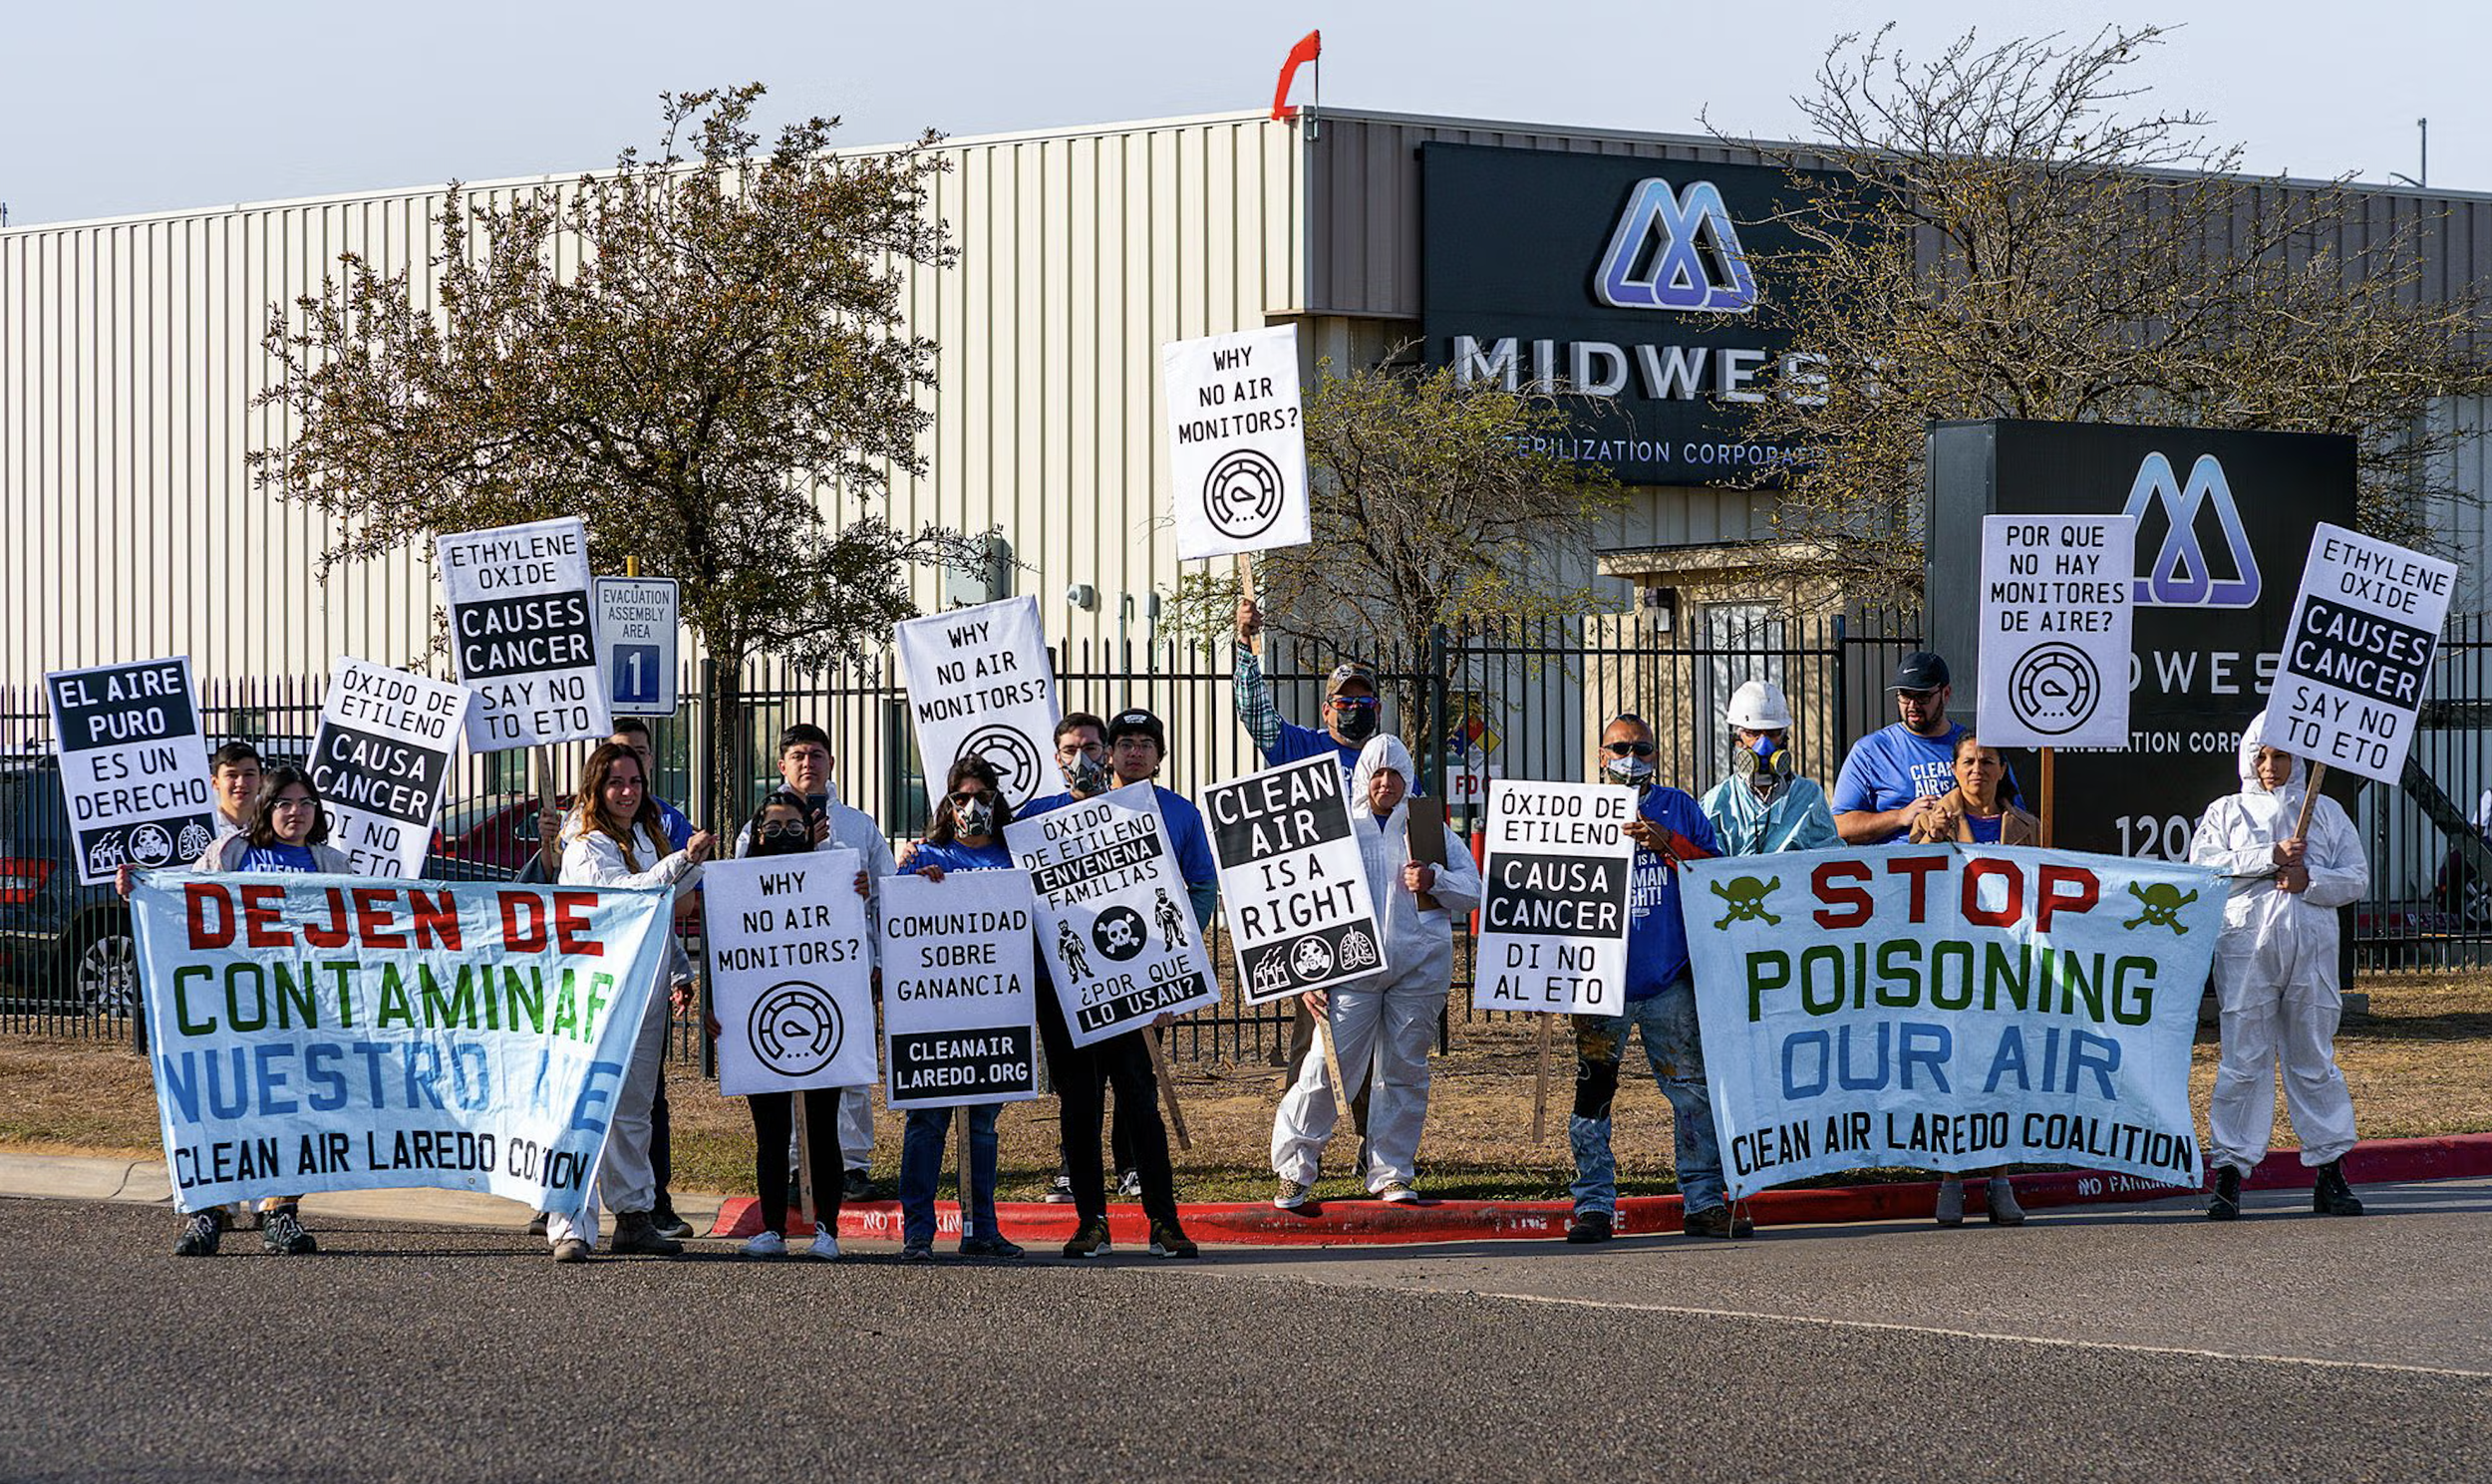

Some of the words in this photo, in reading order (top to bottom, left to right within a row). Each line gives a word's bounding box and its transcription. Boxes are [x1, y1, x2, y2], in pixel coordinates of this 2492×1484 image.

[1213, 346, 1252, 371] WHY
[1199, 385, 1224, 407] NO
[1234, 377, 1273, 402] AIR
[1179, 408, 1298, 444] MONITORS?
[452, 534, 577, 567] ETHYLENE
[2007, 525, 2049, 547] POR
[2060, 525, 2104, 548] QUE
[478, 562, 556, 589] OXIDE
[2011, 554, 2038, 575] NO
[2056, 554, 2099, 575] HAY
[2323, 539, 2448, 597] ETHYLENE
[604, 589, 669, 605] EVACUATION
[1992, 582, 2125, 604] MONITORES
[2340, 572, 2416, 615] OXIDE
[462, 598, 585, 637] CAUSES
[609, 606, 665, 622] ASSEMBLY
[622, 625, 650, 638] AREA
[2001, 611, 2028, 632] DE
[2040, 611, 2113, 632] AIRE?
[947, 621, 989, 648] WHY
[2306, 605, 2426, 667] CAUSES
[466, 637, 589, 673] CANCER
[937, 662, 966, 685] NO
[976, 651, 1017, 678] AIR
[2296, 641, 2416, 703] CANCER
[58, 681, 98, 709] EL
[107, 667, 182, 700] AIRE
[343, 665, 418, 706] ÓXIDO
[427, 691, 457, 717] DE
[628, 652, 641, 696] 1
[482, 683, 534, 711] SAY
[550, 676, 585, 702] NO
[919, 679, 1046, 724] MONITORS?
[89, 708, 166, 742] PURO
[341, 695, 446, 739] ETILENO
[484, 714, 519, 740] TO
[535, 707, 589, 735] ETO
[2294, 686, 2349, 725] SAY
[2358, 708, 2396, 740] NO
[331, 734, 425, 781] CAUSA
[2288, 717, 2321, 749] TO
[2332, 728, 2388, 769] ETO
[93, 753, 129, 781] ES
[142, 746, 177, 774] UN
[76, 777, 206, 820] DERECHO
[313, 764, 429, 818] CANCER
[1214, 764, 1335, 825] CLEAN
[1501, 788, 1581, 818] ÓXIDO
[1596, 798, 1626, 819] DE
[1915, 779, 1940, 797] AIR
[364, 821, 400, 851] NO
[1044, 804, 1111, 842] ÓXIDO
[1251, 814, 1321, 857] AIR
[1504, 822, 1618, 845] ETILENO
[2115, 814, 2202, 860] 120
[1023, 852, 1052, 873] DE
[1061, 813, 1155, 861] ETILENO
[1638, 854, 1648, 866] IS
[1650, 853, 1657, 864] A
[761, 871, 805, 896] WHY
[1042, 842, 1152, 890] ENVENENA
[1264, 860, 1297, 892] IS
[1308, 853, 1325, 878] A
[1504, 860, 1609, 892] CAUSA
[1632, 866, 1668, 887] MAN
[1048, 862, 1158, 911] FAMILIAS
[1811, 856, 2100, 933] STOP
[184, 882, 462, 951] DEJEN
[496, 891, 603, 956] DE
[744, 910, 773, 933] NO
[785, 904, 830, 929] AIR
[888, 910, 1027, 938] COMUNIDAD
[1240, 879, 1357, 940] RIGHT
[1489, 897, 1617, 931] CANCER
[719, 939, 859, 972] MONITORS?
[921, 944, 996, 968] SOBRE
[1507, 944, 1539, 969] DI
[1559, 945, 1596, 972] NO
[897, 974, 1021, 1001] GANANCIA
[1081, 973, 1132, 1006] ¿POR
[1148, 955, 1190, 984] QUE
[1495, 975, 1530, 1002] AL
[1546, 978, 1603, 1005] ETO
[1746, 939, 2158, 1026] POISONING
[1087, 1004, 1113, 1029] LO
[1131, 979, 1195, 1017] USAN?
[909, 1037, 1014, 1062] CLEANAIR
[1782, 1022, 1951, 1101] OUR
[1984, 1027, 2121, 1101] AIR
[162, 1042, 488, 1125] NUESTRO
[897, 1062, 1028, 1090] LAREDO.ORG
[174, 1137, 279, 1189] CLEAN
[298, 1132, 351, 1174] AIR
[368, 1131, 495, 1171] LAREDO
[1732, 1120, 1811, 1177] CLEAN
[1825, 1111, 1871, 1154] AIR
[1887, 1111, 2009, 1154] LAREDO
[2023, 1113, 2193, 1172] COALITION
[2078, 1178, 2101, 1196] NO
[863, 1213, 888, 1230] NO
